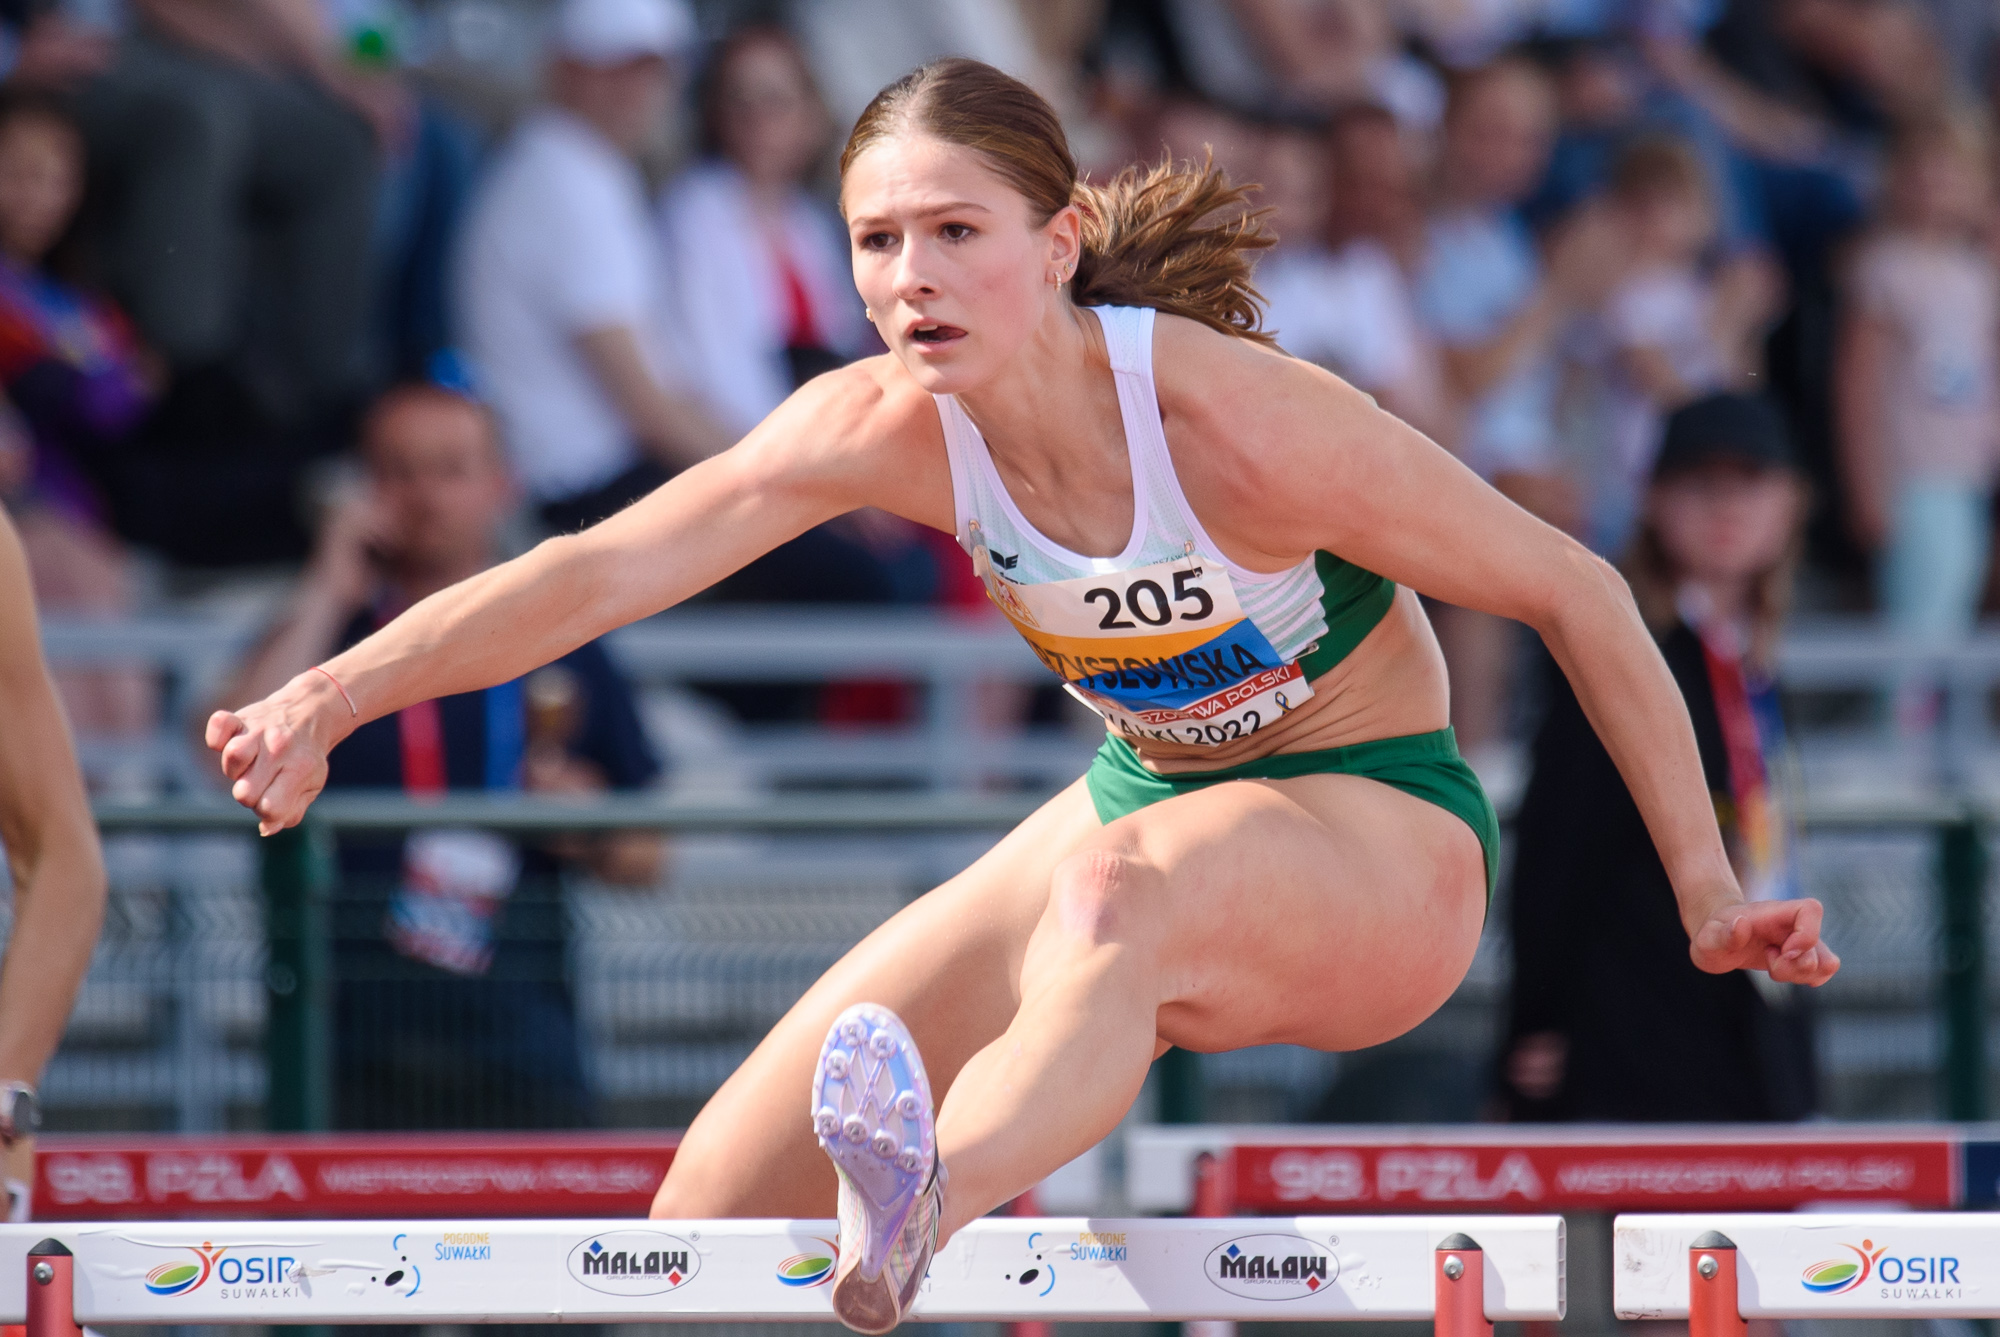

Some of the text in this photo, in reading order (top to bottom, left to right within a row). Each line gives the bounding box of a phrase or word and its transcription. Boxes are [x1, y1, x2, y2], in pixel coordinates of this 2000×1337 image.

[1083, 566, 1214, 630] 205
[1225, 665, 1291, 706] POLSKI
[1186, 710, 1261, 745] 2022
[443, 1232, 490, 1244] POGODNE
[1079, 1232, 1127, 1245] POGODNE
[434, 1242, 491, 1261] SUWAŁKI
[1070, 1242, 1127, 1261] SUWAŁKI
[583, 1251, 688, 1275] MALOW
[1220, 1255, 1327, 1279] MALOW
[1879, 1257, 1961, 1284] OSIR
[220, 1287, 299, 1299] SUWAŁKI
[1880, 1288, 1962, 1299] SUWAŁKI
